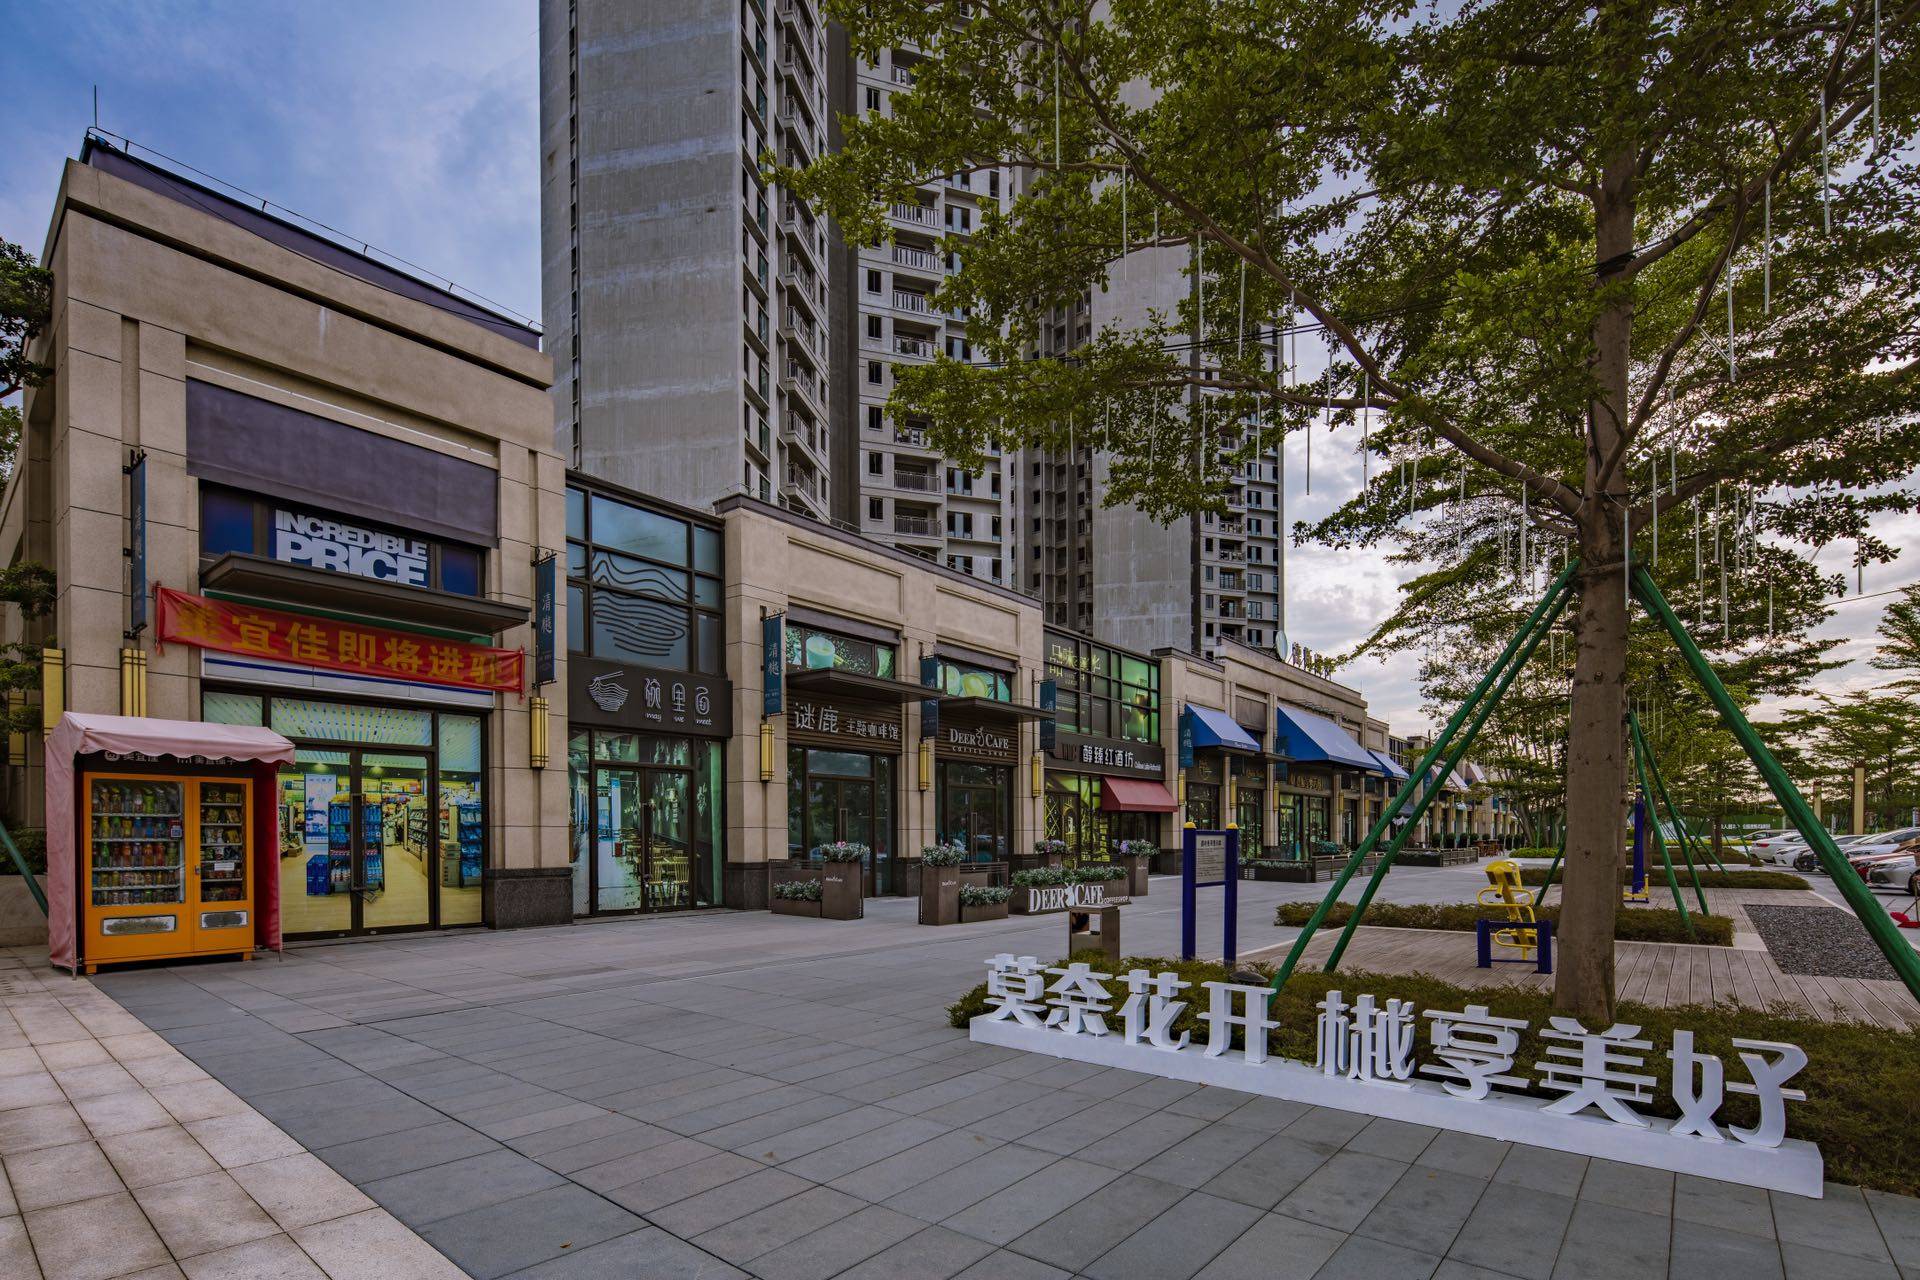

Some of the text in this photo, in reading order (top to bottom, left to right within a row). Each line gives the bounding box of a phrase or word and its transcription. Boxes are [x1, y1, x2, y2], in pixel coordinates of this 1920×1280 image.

[275, 508, 428, 562] INCREDIBLE
[275, 529, 428, 589] PRICE
[794, 702, 899, 740] 谜鹿 主题咖啡馆
[949, 728, 977, 745] DEER
[1082, 745, 1135, 767] 醇臻红酒坊
[1028, 888, 1066, 913] DEER
[1074, 884, 1105, 906] CAFE
[983, 953, 1281, 1064] 莫奈花开
